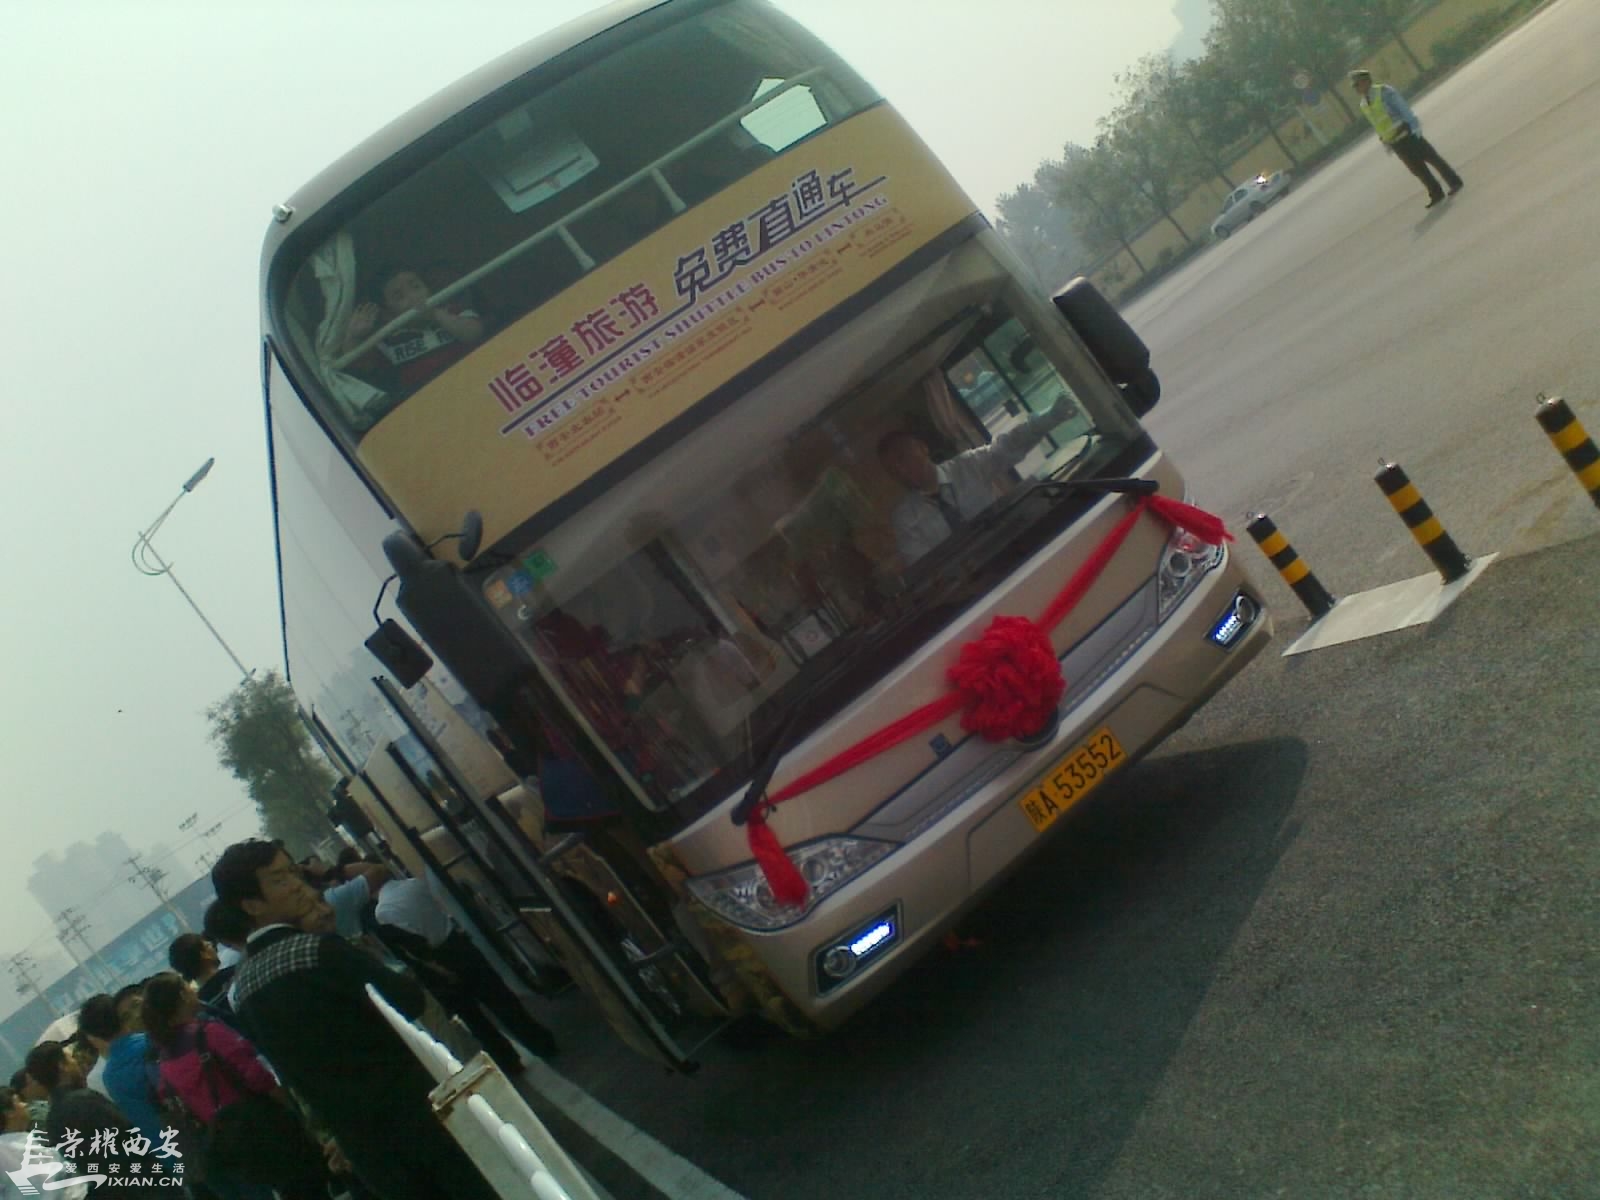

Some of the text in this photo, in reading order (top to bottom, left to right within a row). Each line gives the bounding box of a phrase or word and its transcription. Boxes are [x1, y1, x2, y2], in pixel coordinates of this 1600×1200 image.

[488, 282, 659, 412] 临潼旅游
[674, 168, 862, 304] 免费直通车
[524, 399, 575, 437] FREE
[577, 338, 662, 399] TOURIST
[664, 282, 748, 338] SHUTTLE
[750, 258, 788, 284] BUS
[789, 239, 813, 258] TO
[814, 196, 888, 243] LINTONG
